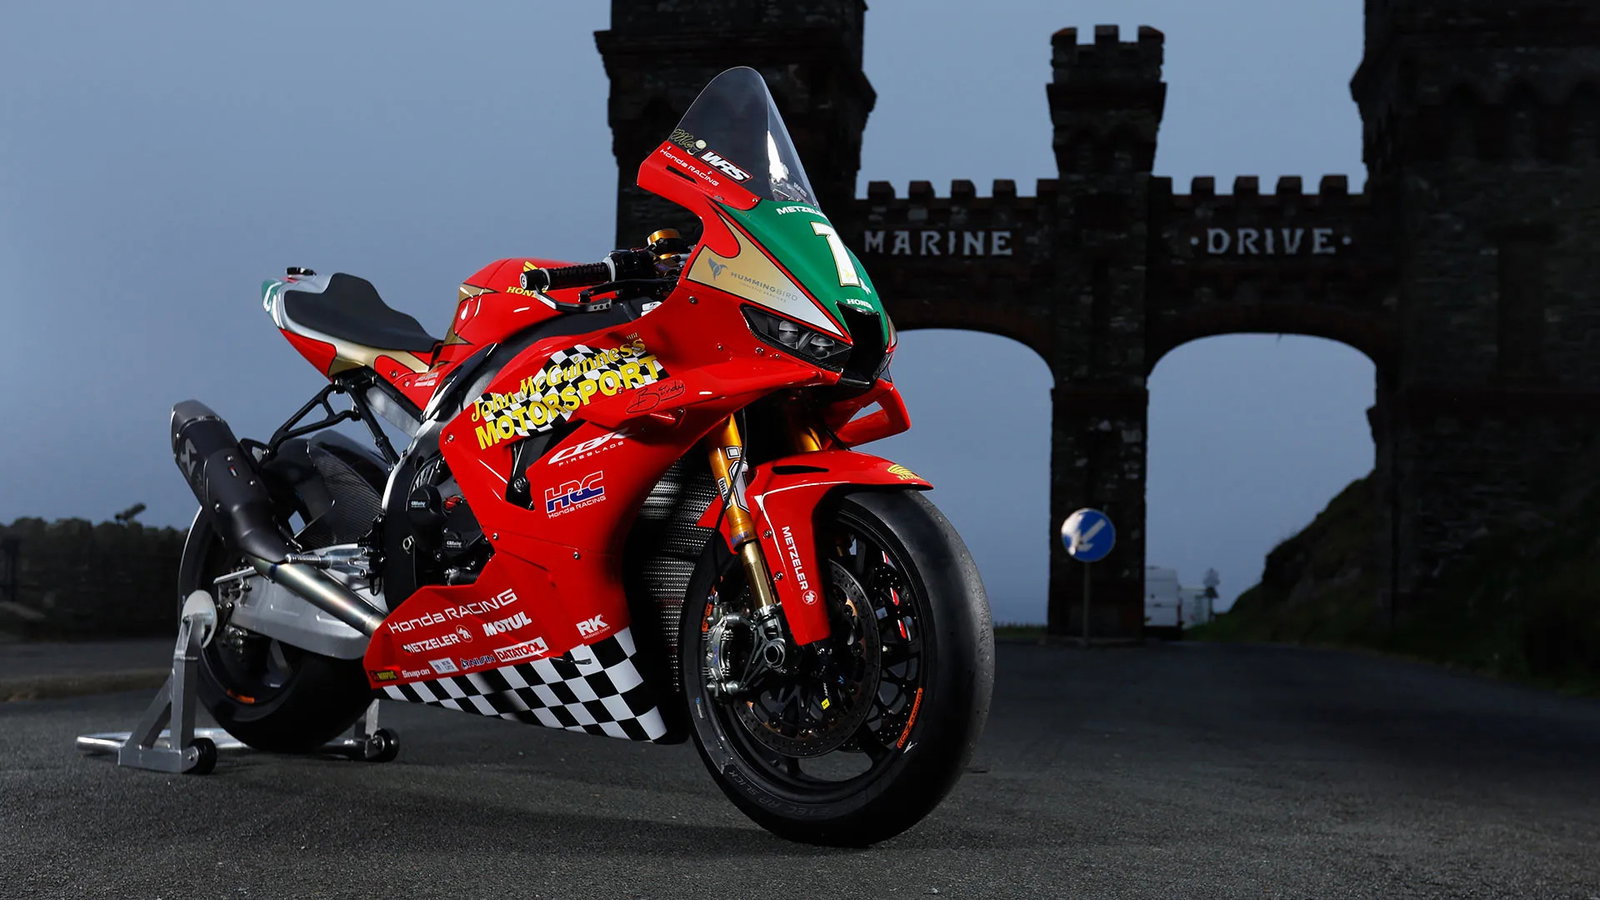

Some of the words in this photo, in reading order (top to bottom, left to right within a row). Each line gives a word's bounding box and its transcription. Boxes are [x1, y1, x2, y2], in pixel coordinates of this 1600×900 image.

[660, 149, 689, 168] Honda
[688, 165, 720, 187] RACING
[701, 151, 750, 181] WRS
[864, 230, 1013, 256] MARINE
[730, 271, 799, 302] HUMMINGBIRD
[471, 392, 519, 422] John
[518, 337, 646, 401] McGuinness
[475, 354, 660, 450] MOTORSPORT
[558, 440, 624, 467] FIREBLADE
[544, 469, 605, 514] HRC
[547, 507, 576, 519] Honda
[575, 495, 607, 510] RACING
[781, 526, 809, 590] METZELER
[388, 612, 445, 634] Honda
[444, 588, 518, 620] RACING
[482, 611, 533, 637] MOTUL
[576, 614, 609, 636] RK
[403, 634, 460, 654] METZELER
[497, 641, 545, 660] DATATOOL
